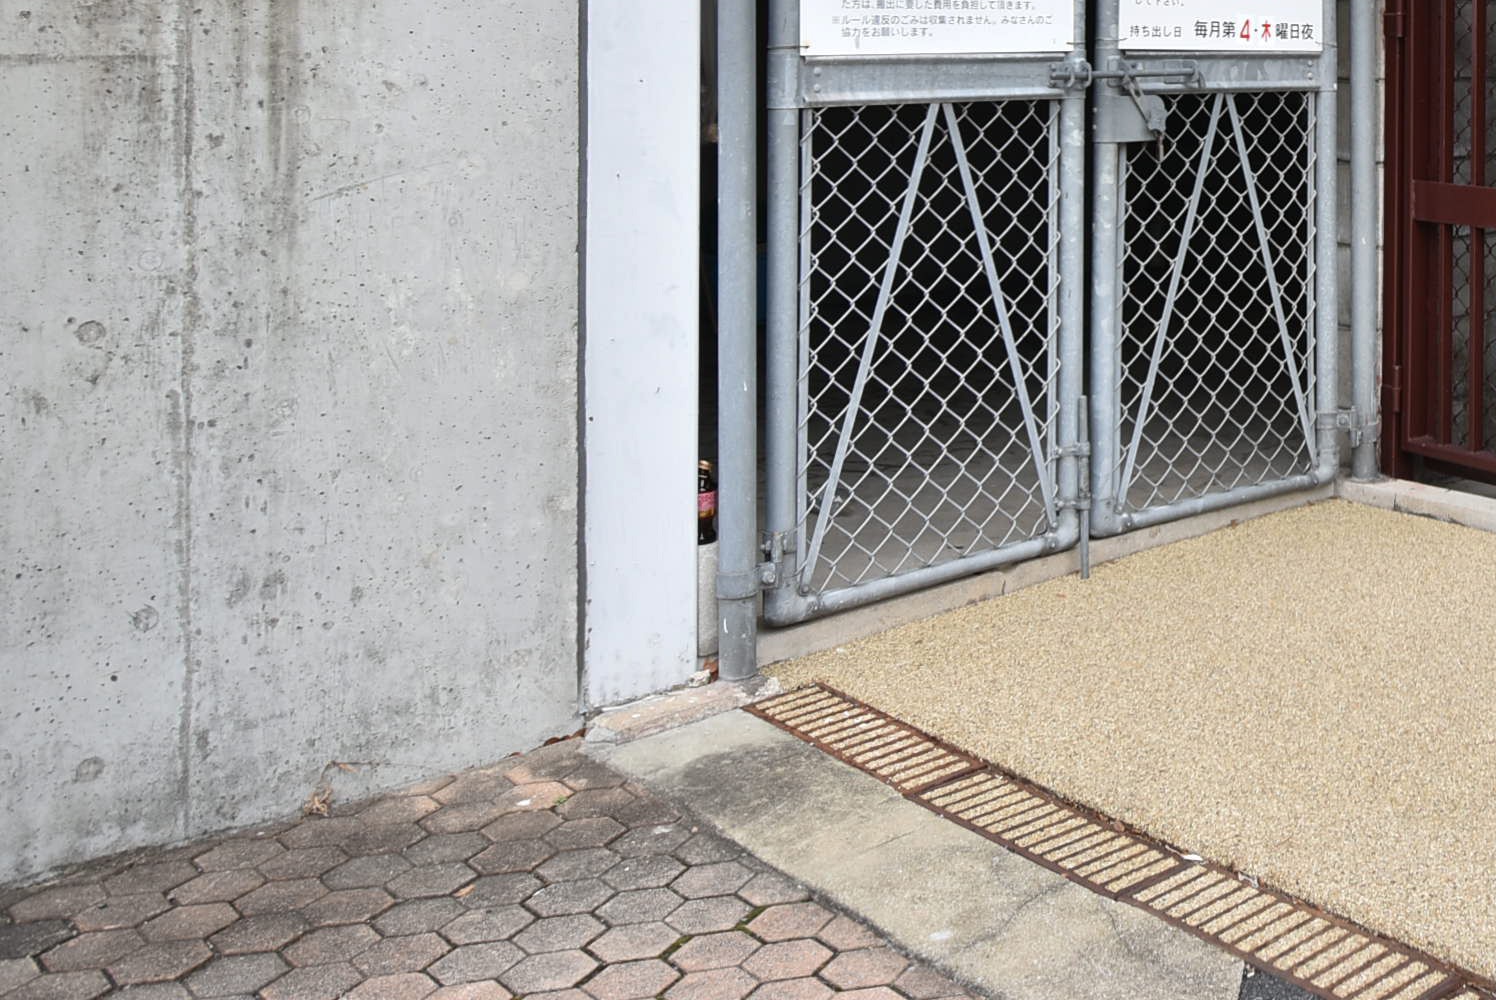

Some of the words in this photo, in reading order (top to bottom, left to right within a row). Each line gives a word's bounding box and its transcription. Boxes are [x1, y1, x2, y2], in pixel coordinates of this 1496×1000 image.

[1129, 25, 1182, 38] 持ち出し日
